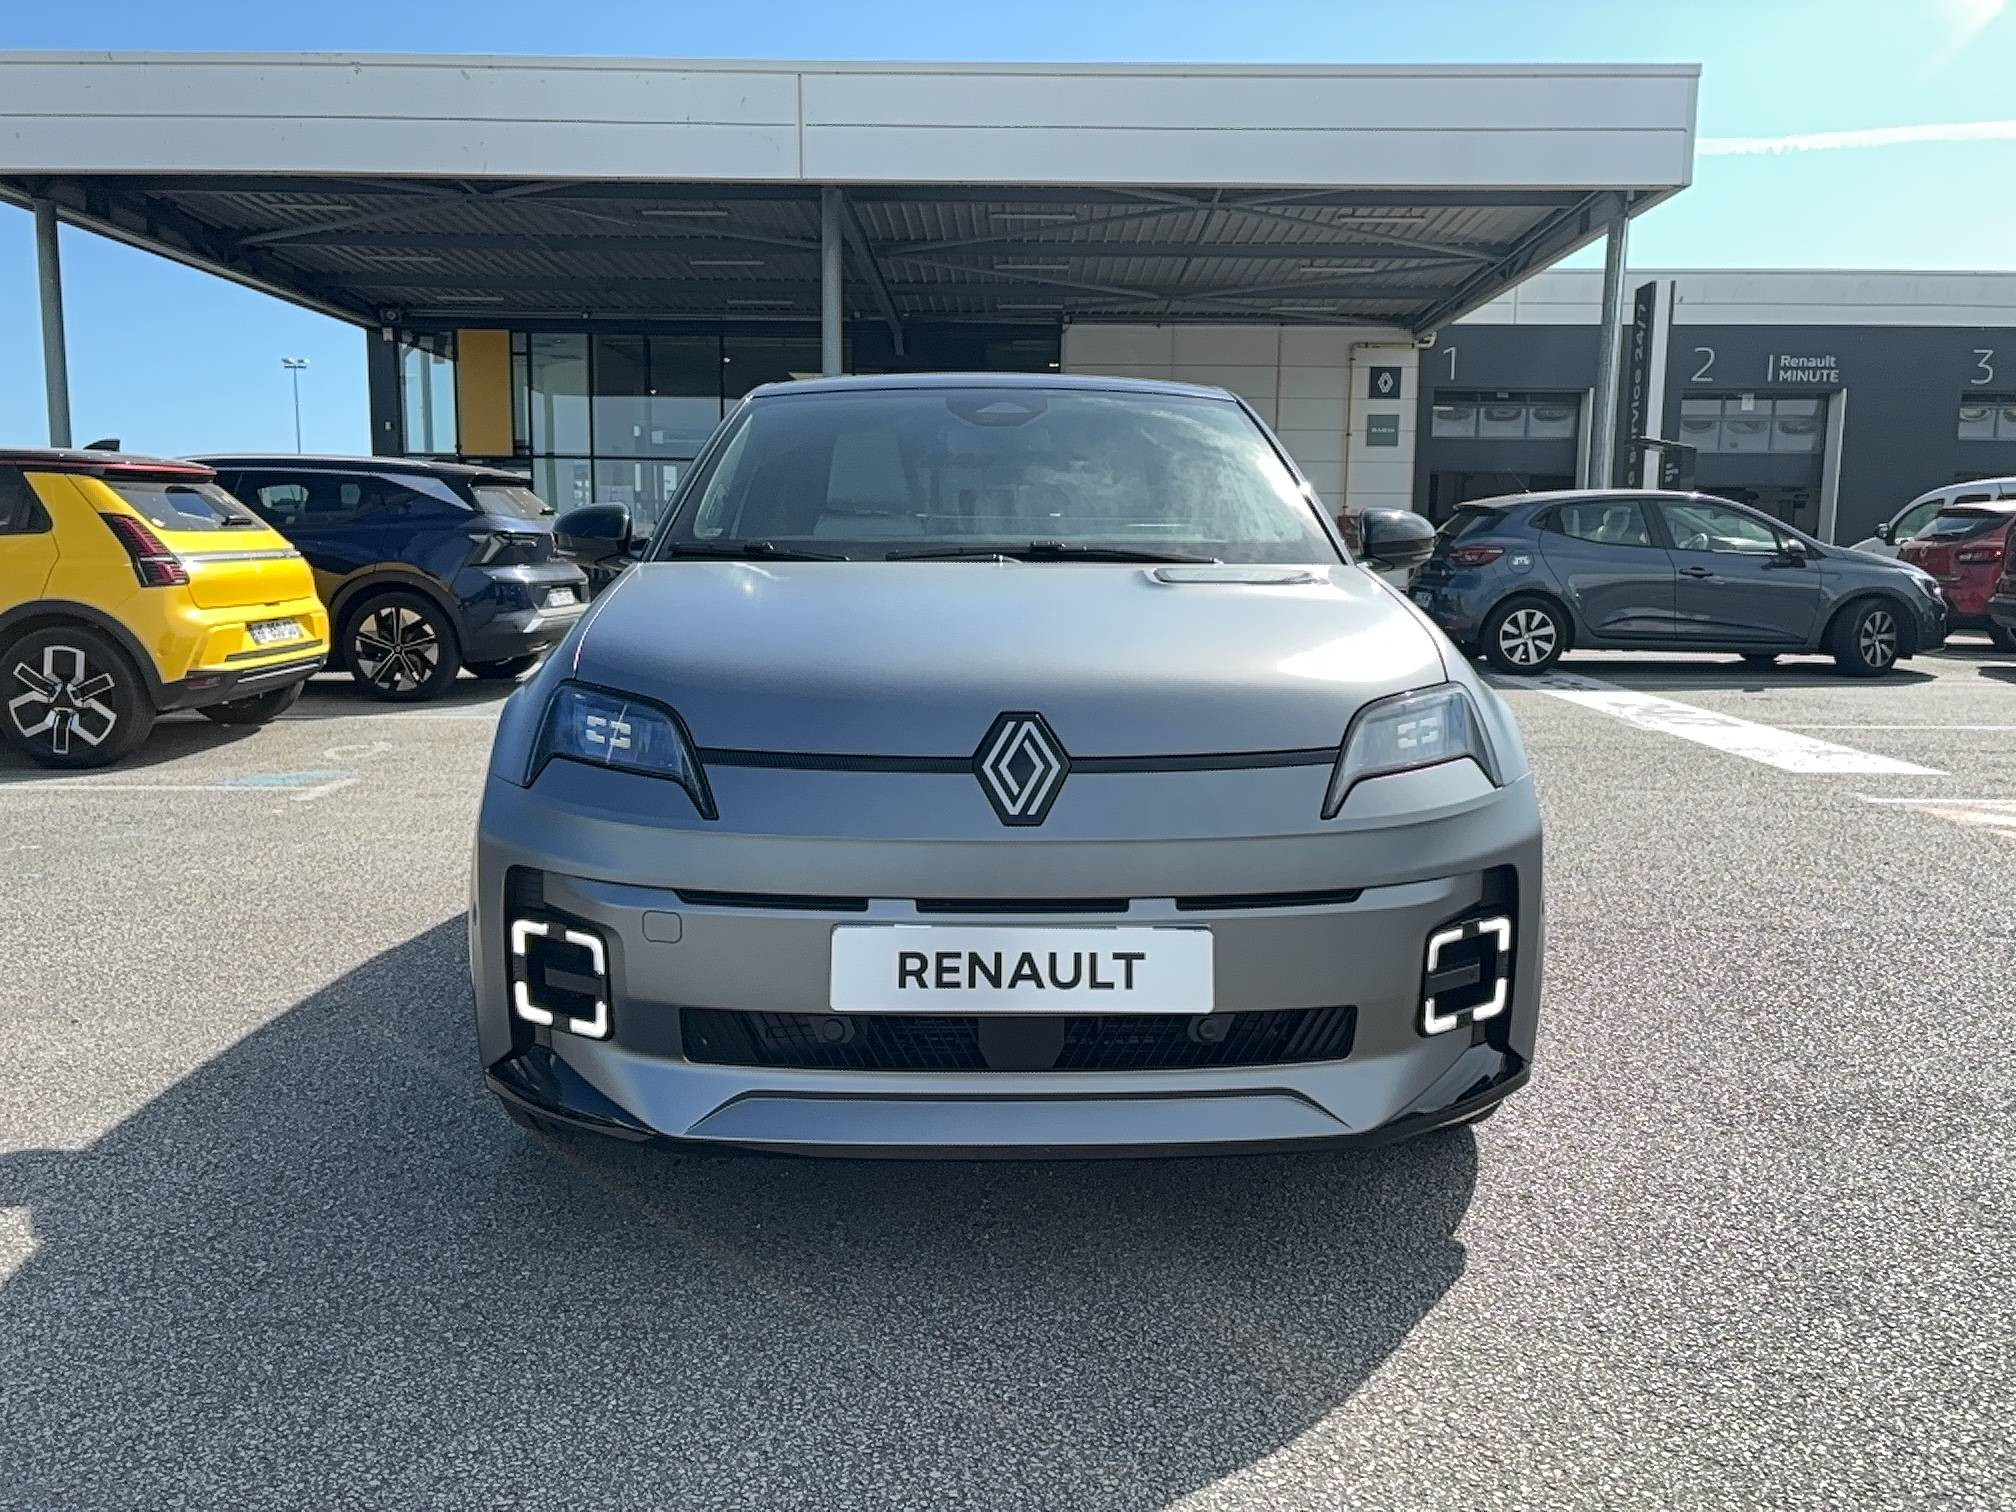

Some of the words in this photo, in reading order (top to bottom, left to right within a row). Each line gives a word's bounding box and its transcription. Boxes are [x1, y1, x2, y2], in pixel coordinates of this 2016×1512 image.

[1634, 303, 1647, 361] 24/7
[1443, 346, 1456, 380] 1
[1691, 347, 1716, 382] 2
[1780, 355, 1836, 368] Renault
[1780, 369, 1839, 382] MINUTE
[1971, 349, 1994, 384] 3
[898, 951, 1146, 990] RENAULT
